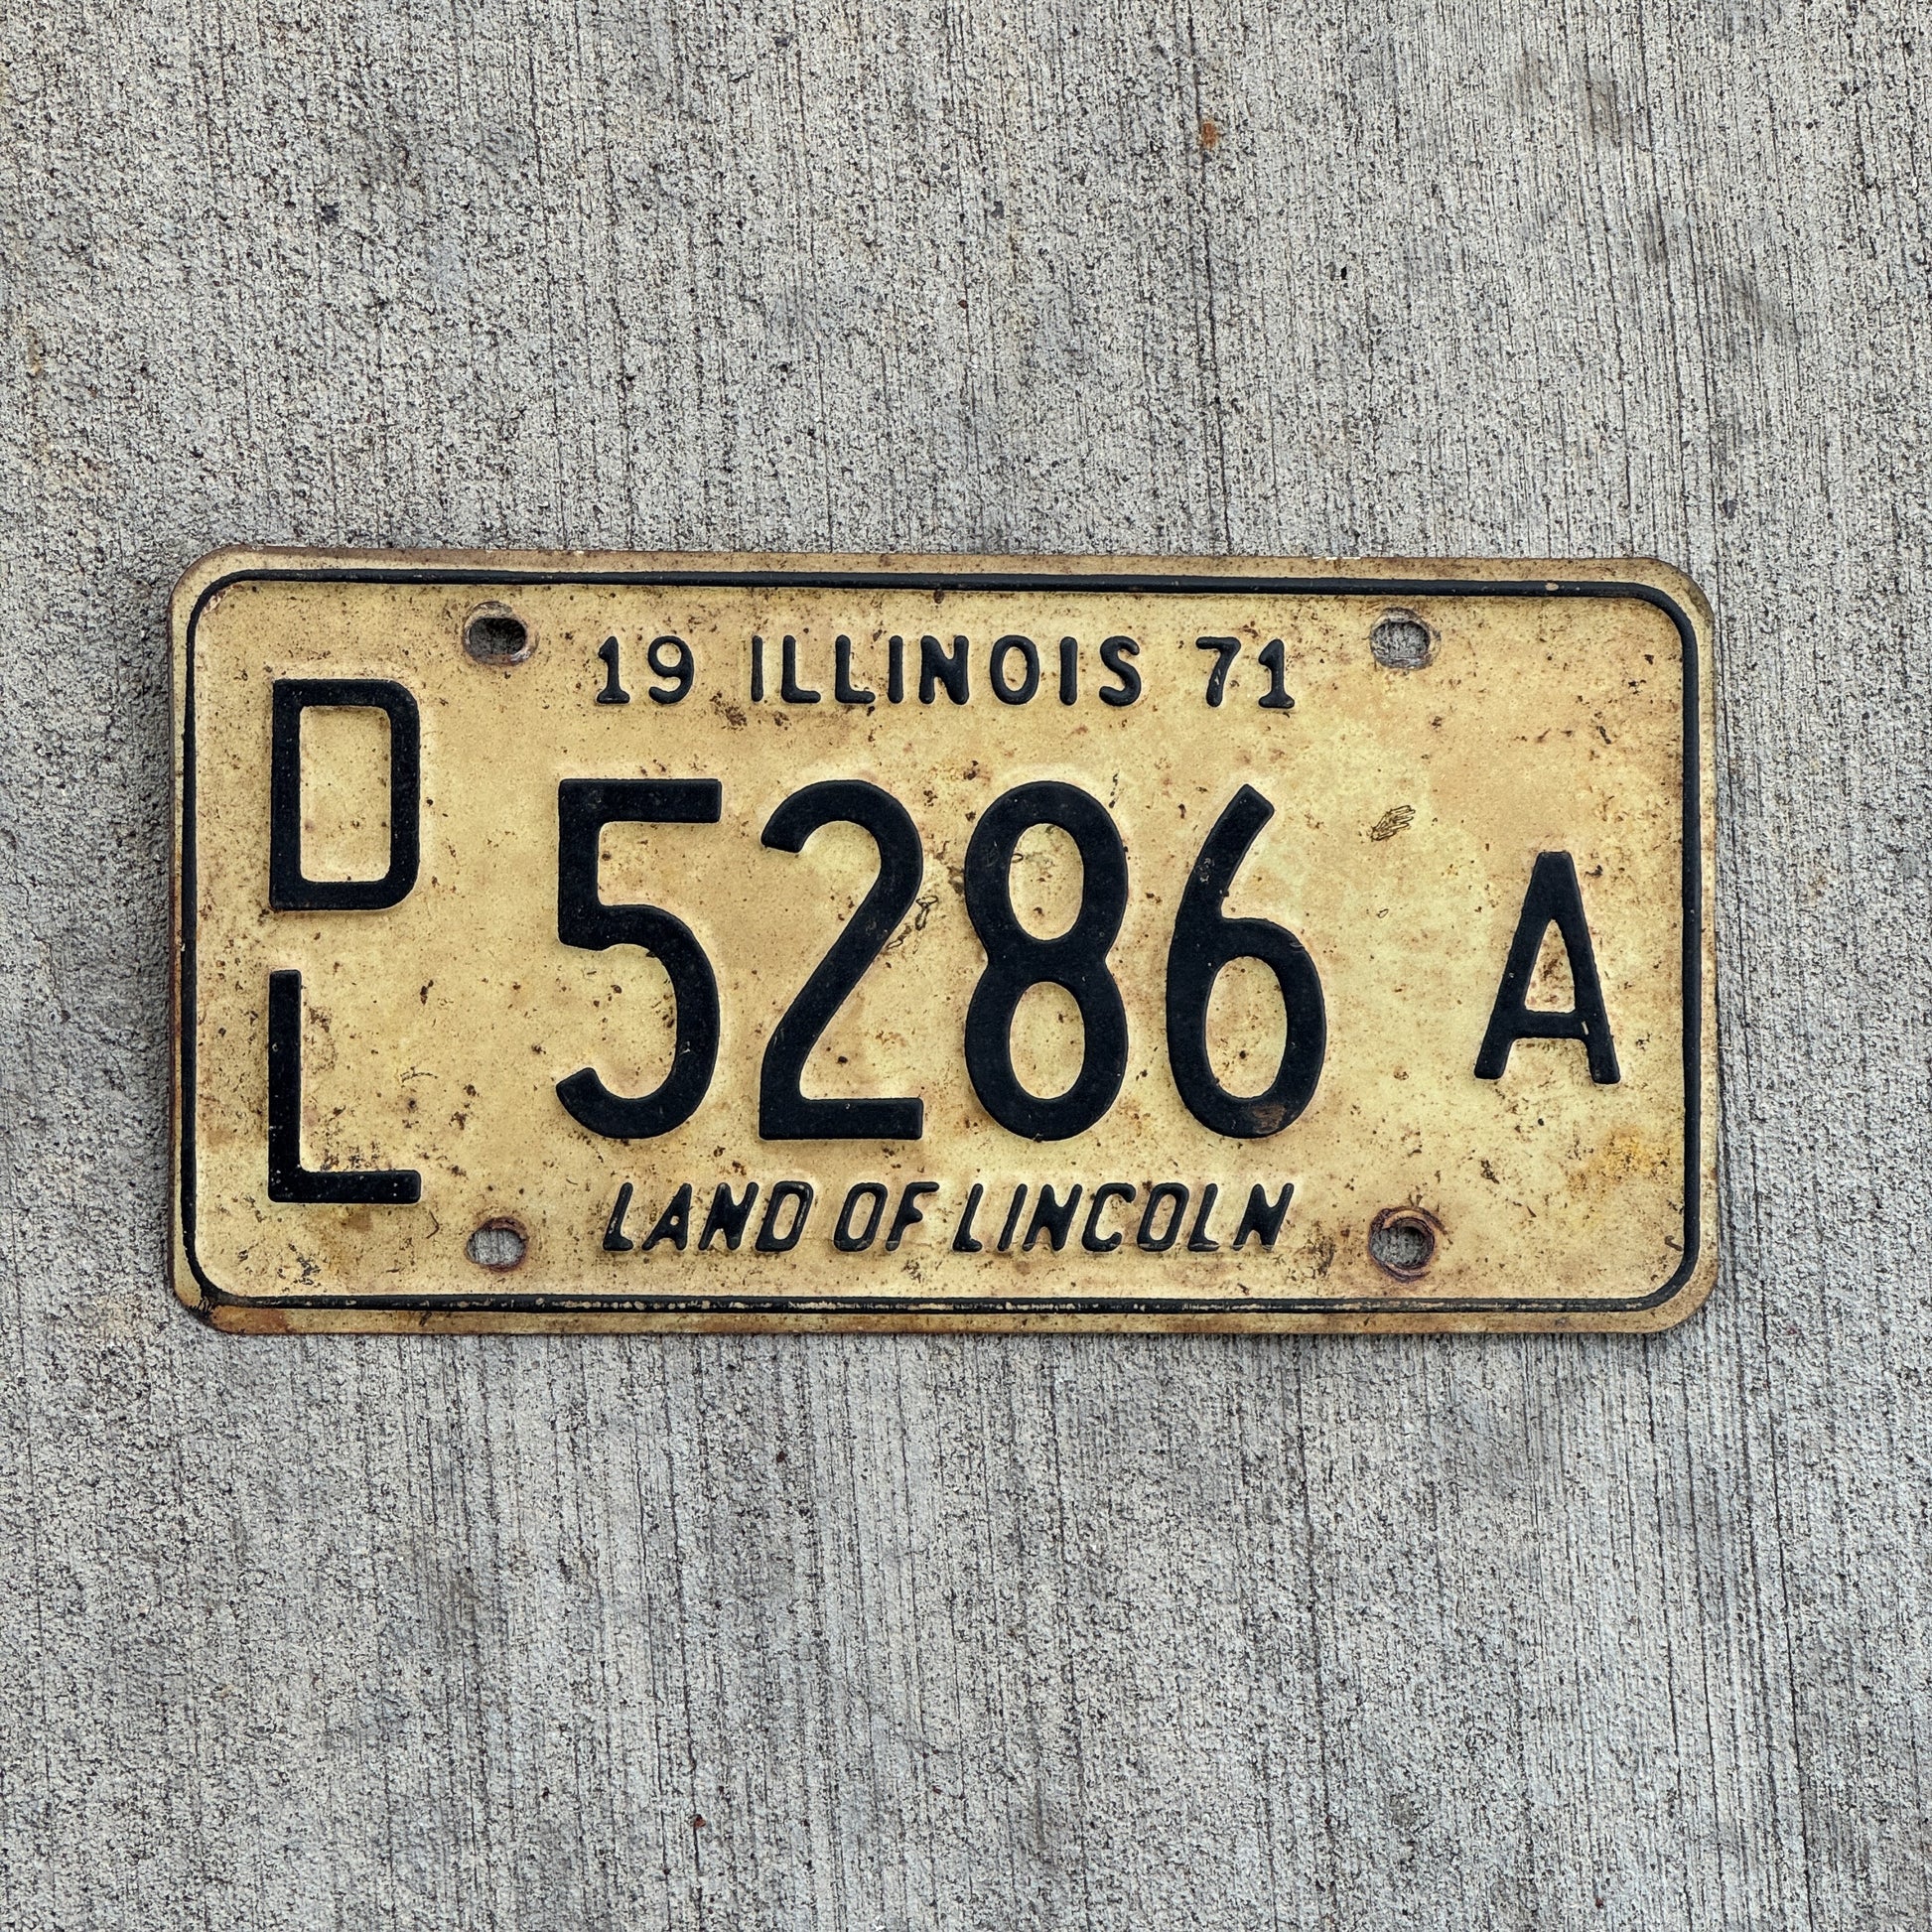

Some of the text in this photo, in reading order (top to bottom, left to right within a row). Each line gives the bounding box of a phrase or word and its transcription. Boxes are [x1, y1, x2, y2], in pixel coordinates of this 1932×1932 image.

[595, 633, 1297, 710] 19 ILLINOIS 71
[555, 777, 1621, 1144] 5286 A
[602, 1180, 1296, 1255] LAND OF LINCOLN
